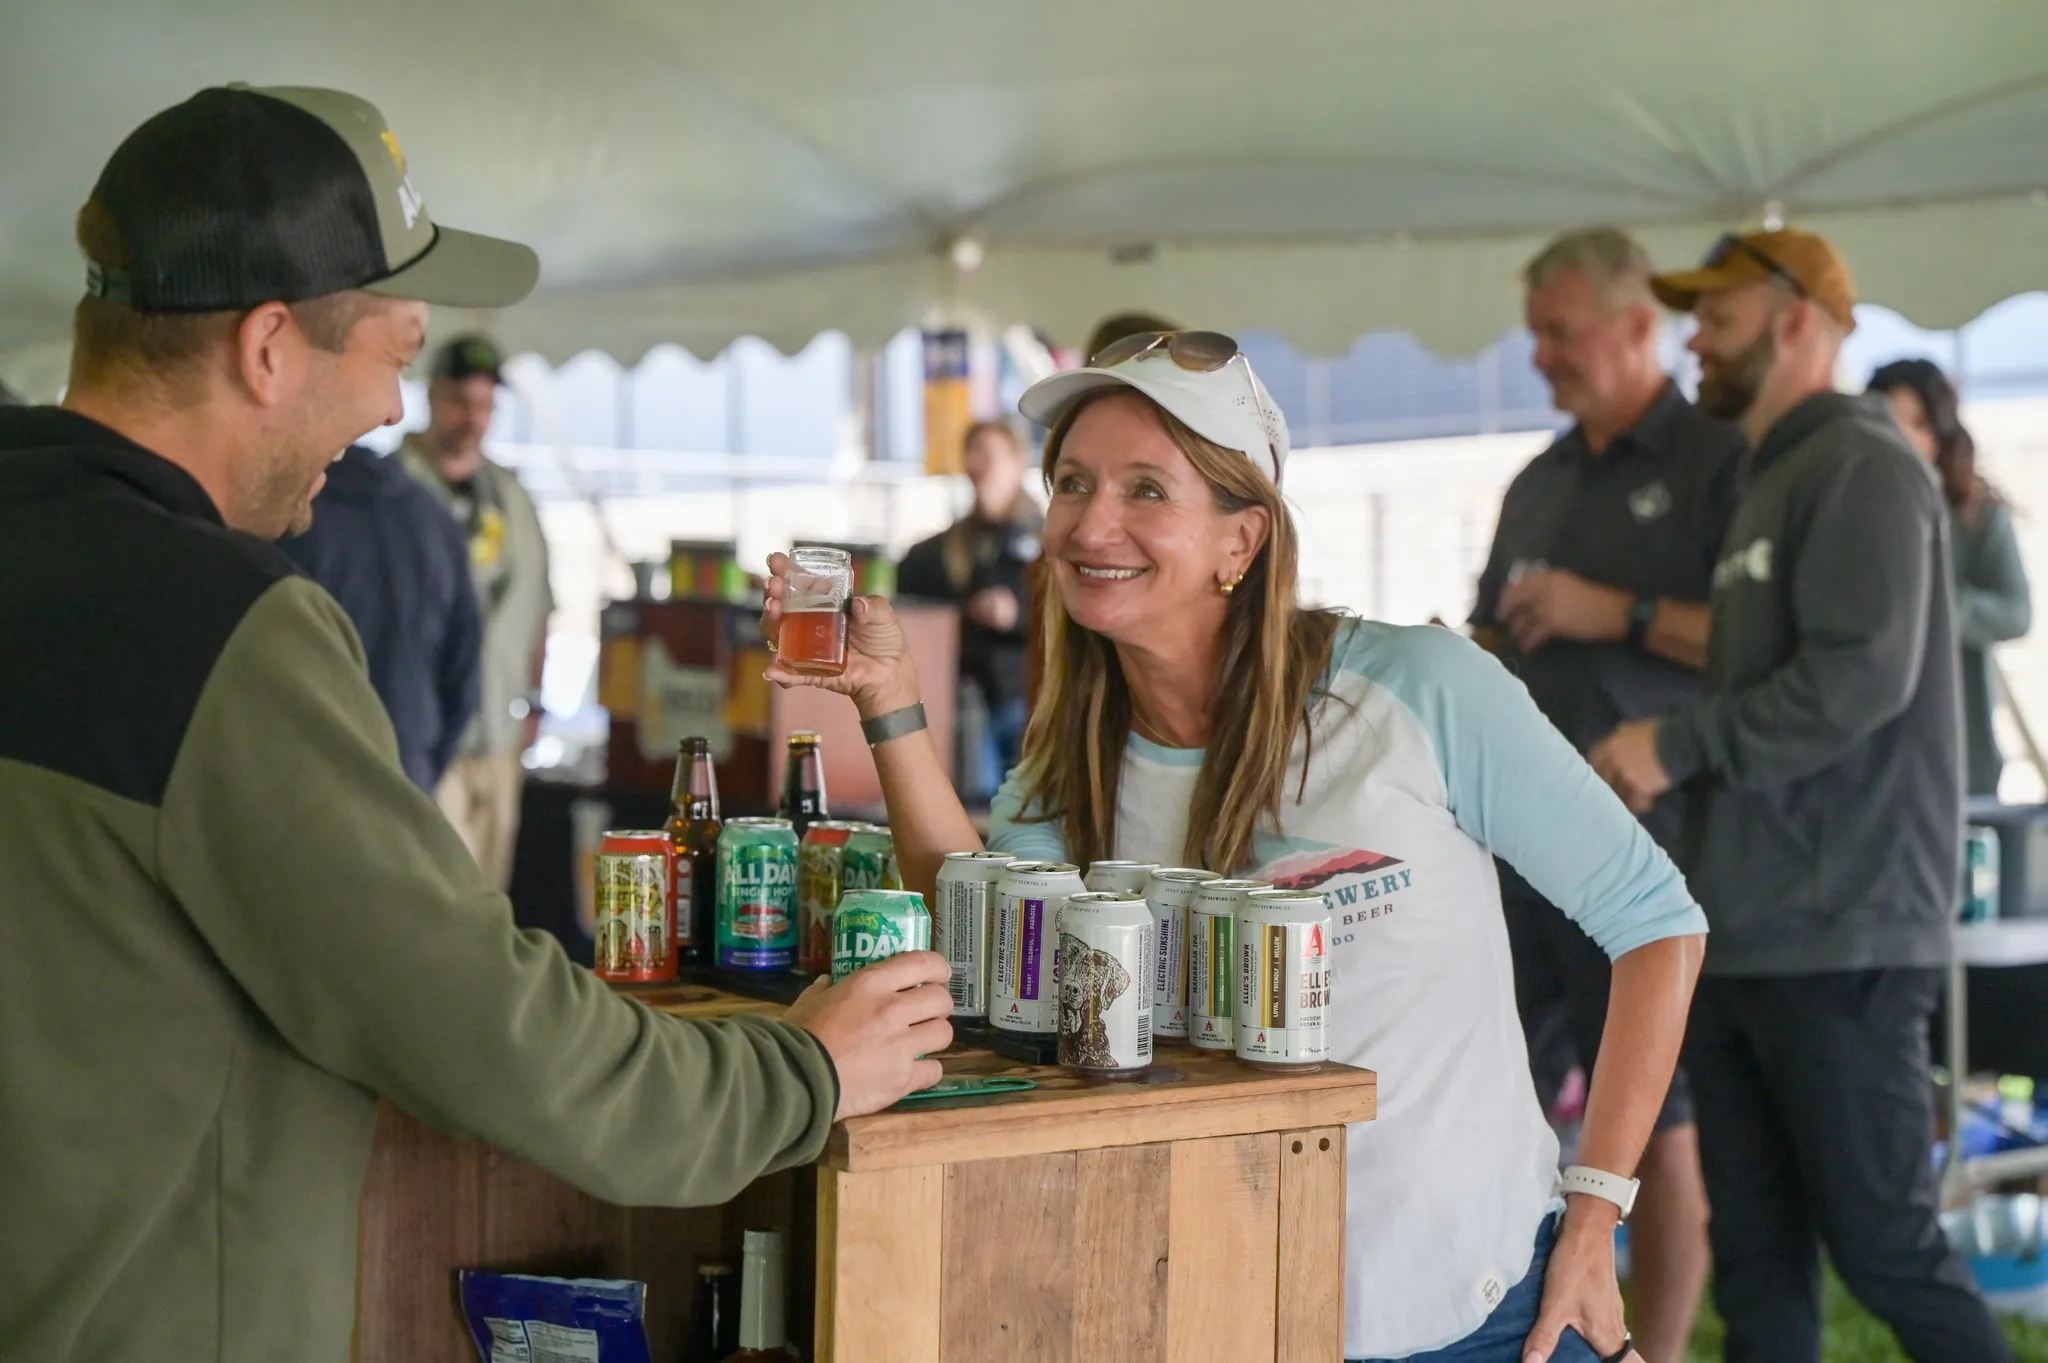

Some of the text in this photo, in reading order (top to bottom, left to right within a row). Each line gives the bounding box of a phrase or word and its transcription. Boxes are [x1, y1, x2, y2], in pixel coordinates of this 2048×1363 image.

[724, 862, 798, 884] ALL DAY
[845, 866, 880, 889] DAY
[1322, 868, 1412, 910] EWERY
[1342, 903, 1394, 926] BEER
[834, 932, 909, 959] LL DAY
[1301, 923, 1327, 958] A
[1157, 919, 1169, 991] ELECTRIC SUNSHINE
[1299, 988, 1332, 1009] BROW
